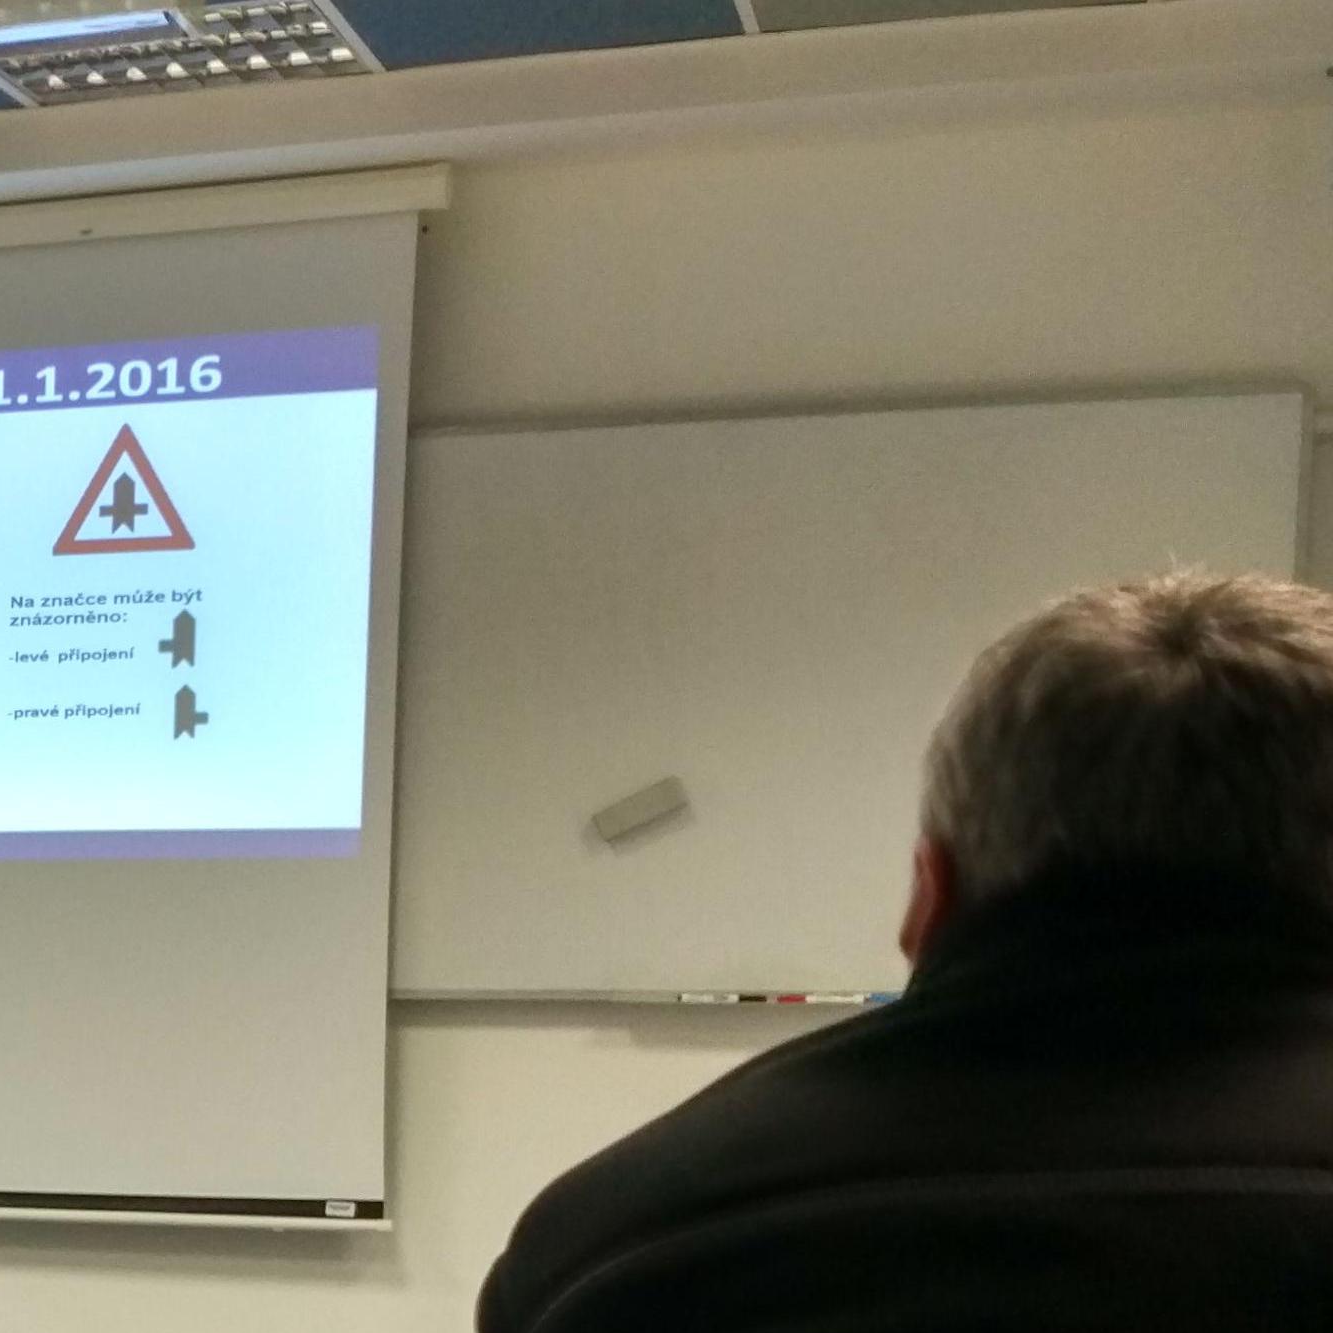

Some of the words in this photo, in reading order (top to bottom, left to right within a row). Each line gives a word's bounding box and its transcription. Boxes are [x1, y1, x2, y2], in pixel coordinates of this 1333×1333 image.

[10, 596, 34, 609] Na
[41, 593, 108, 608] značce
[171, 588, 202, 605] být
[9, 609, 128, 627] znázorněno:
[58, 646, 135, 664] připojení
[64, 702, 141, 720] připojení
